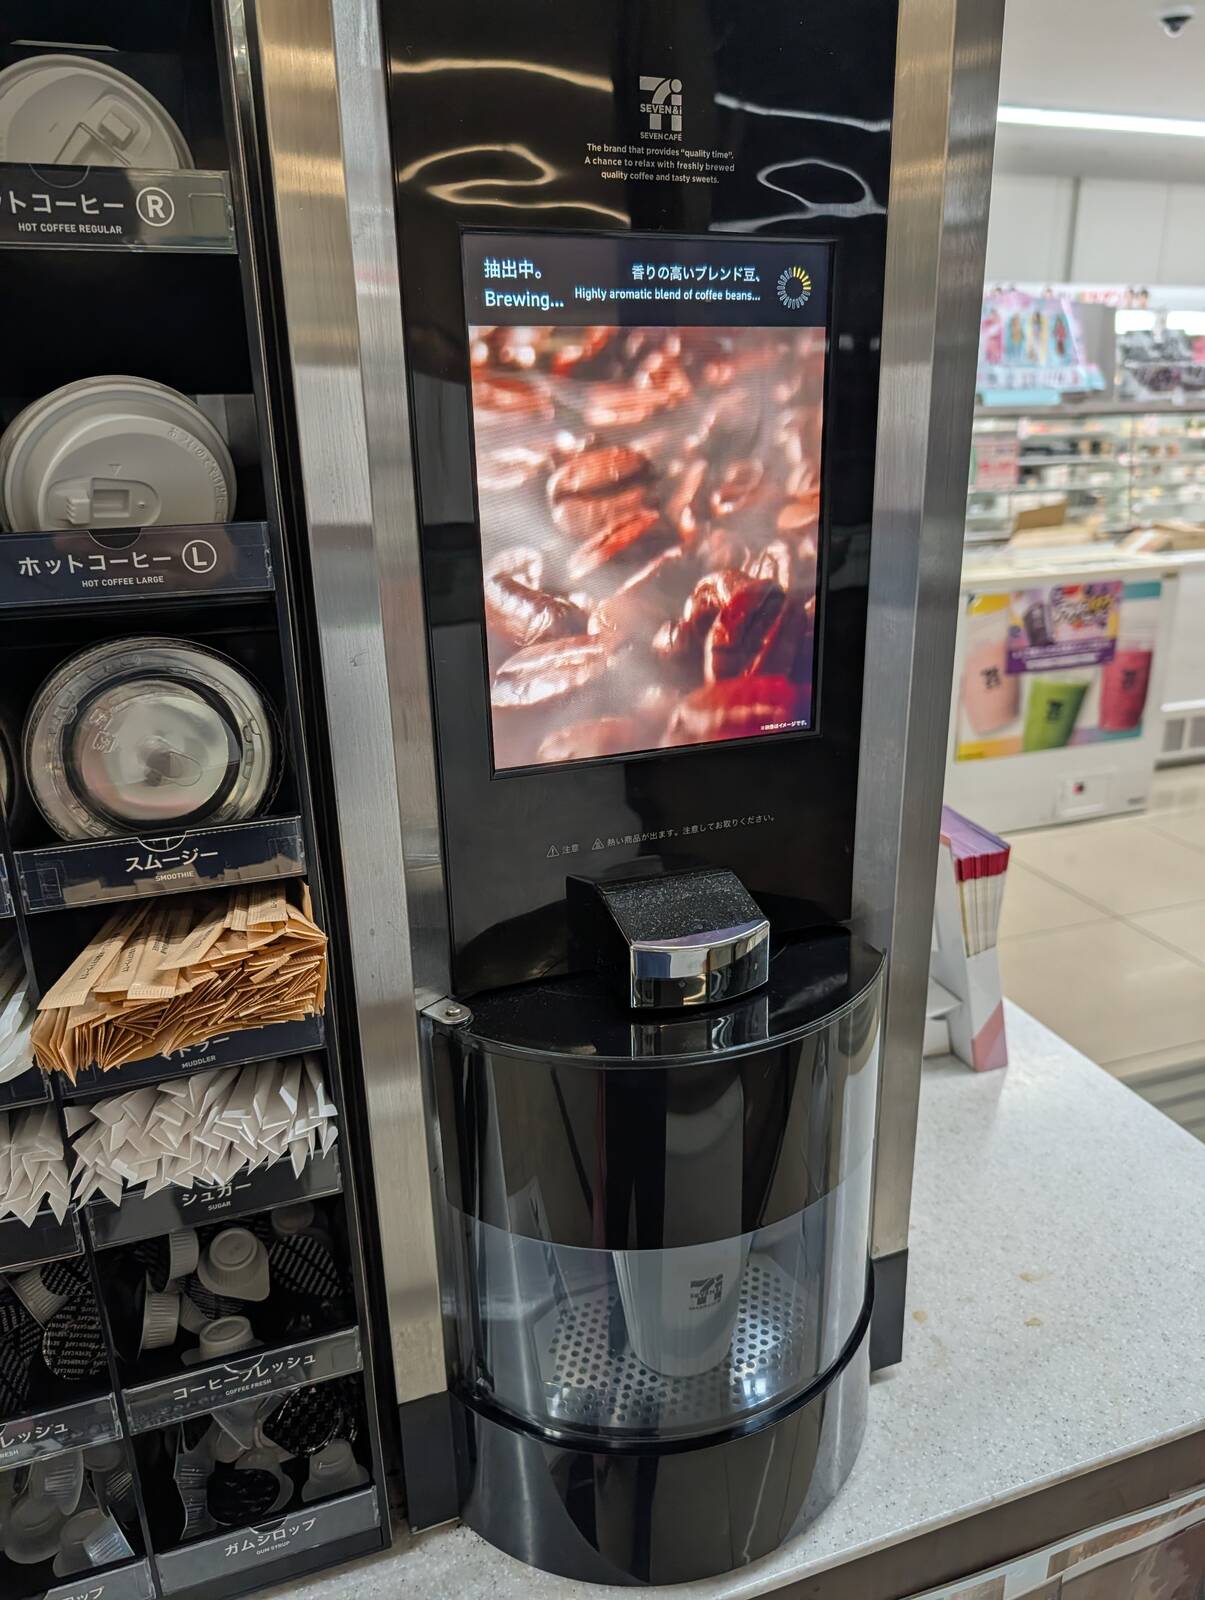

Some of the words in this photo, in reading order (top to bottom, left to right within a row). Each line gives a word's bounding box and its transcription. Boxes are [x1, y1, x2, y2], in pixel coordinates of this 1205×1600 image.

[587, 143, 602, 152] The
[604, 144, 627, 153] brand
[629, 145, 644, 154] that
[646, 147, 679, 156] provides
[584, 156, 591, 164] A
[592, 156, 622, 166] chance
[635, 159, 655, 167] relax
[657, 161, 675, 169] with
[677, 161, 704, 172] freshly
[705, 162, 735, 172] brewed
[601, 170, 628, 180] quality
[630, 172, 654, 180] coffee
[672, 174, 690, 184] tasty
[0, 190, 124, 214] トコーヒー
[18, 222, 37, 232] HOT
[40, 223, 77, 233] COFFEE
[79, 224, 122, 234] REGULAR
[484, 258, 542, 280] 抽出中。
[632, 264, 760, 282] 香りの高いブレンド豆、
[484, 290, 564, 310] Brewing...
[574, 287, 606, 301] Highly
[609, 288, 652, 300] aromatic
[654, 288, 681, 300] blend
[683, 289, 693, 300] of
[695, 289, 722, 300] coffee
[725, 289, 760, 301] beans...
[18, 552, 172, 576] ホットコーヒー
[82, 579, 98, 588] HOT
[101, 578, 134, 587] COFFEE
[136, 575, 164, 585] LARGE
[562, 844, 580, 854] 注意
[126, 847, 218, 872] スムージー
[155, 870, 195, 881] SMOOTHIE
[182, 1055, 216, 1069] MUDDLER
[182, 1183, 252, 1207] シュガー
[208, 1201, 231, 1211] SUGAR
[224, 1517, 316, 1557] ガムシロップ
